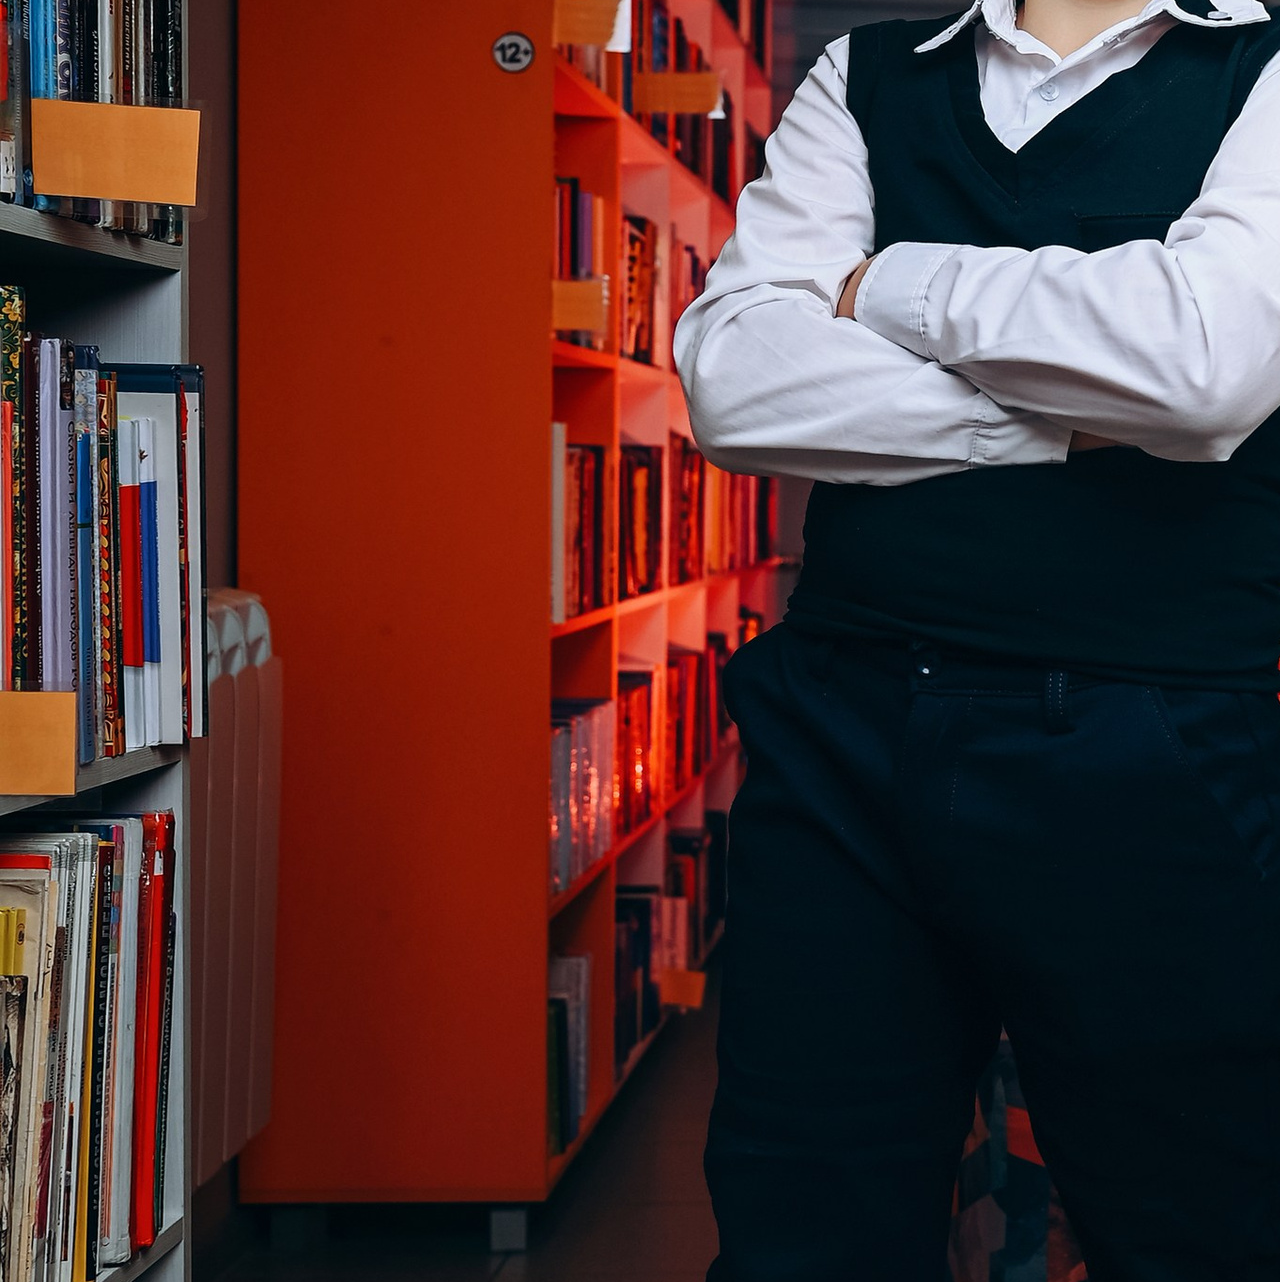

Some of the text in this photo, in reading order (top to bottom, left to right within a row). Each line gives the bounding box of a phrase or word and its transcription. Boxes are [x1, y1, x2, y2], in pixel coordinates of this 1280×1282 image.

[496, 42, 533, 64] 12+
[67, 419, 77, 485] СКАЗКИ
[67, 509, 77, 581] ЛЕГЕНДЫ
[98, 946, 110, 1030] САМОМ
